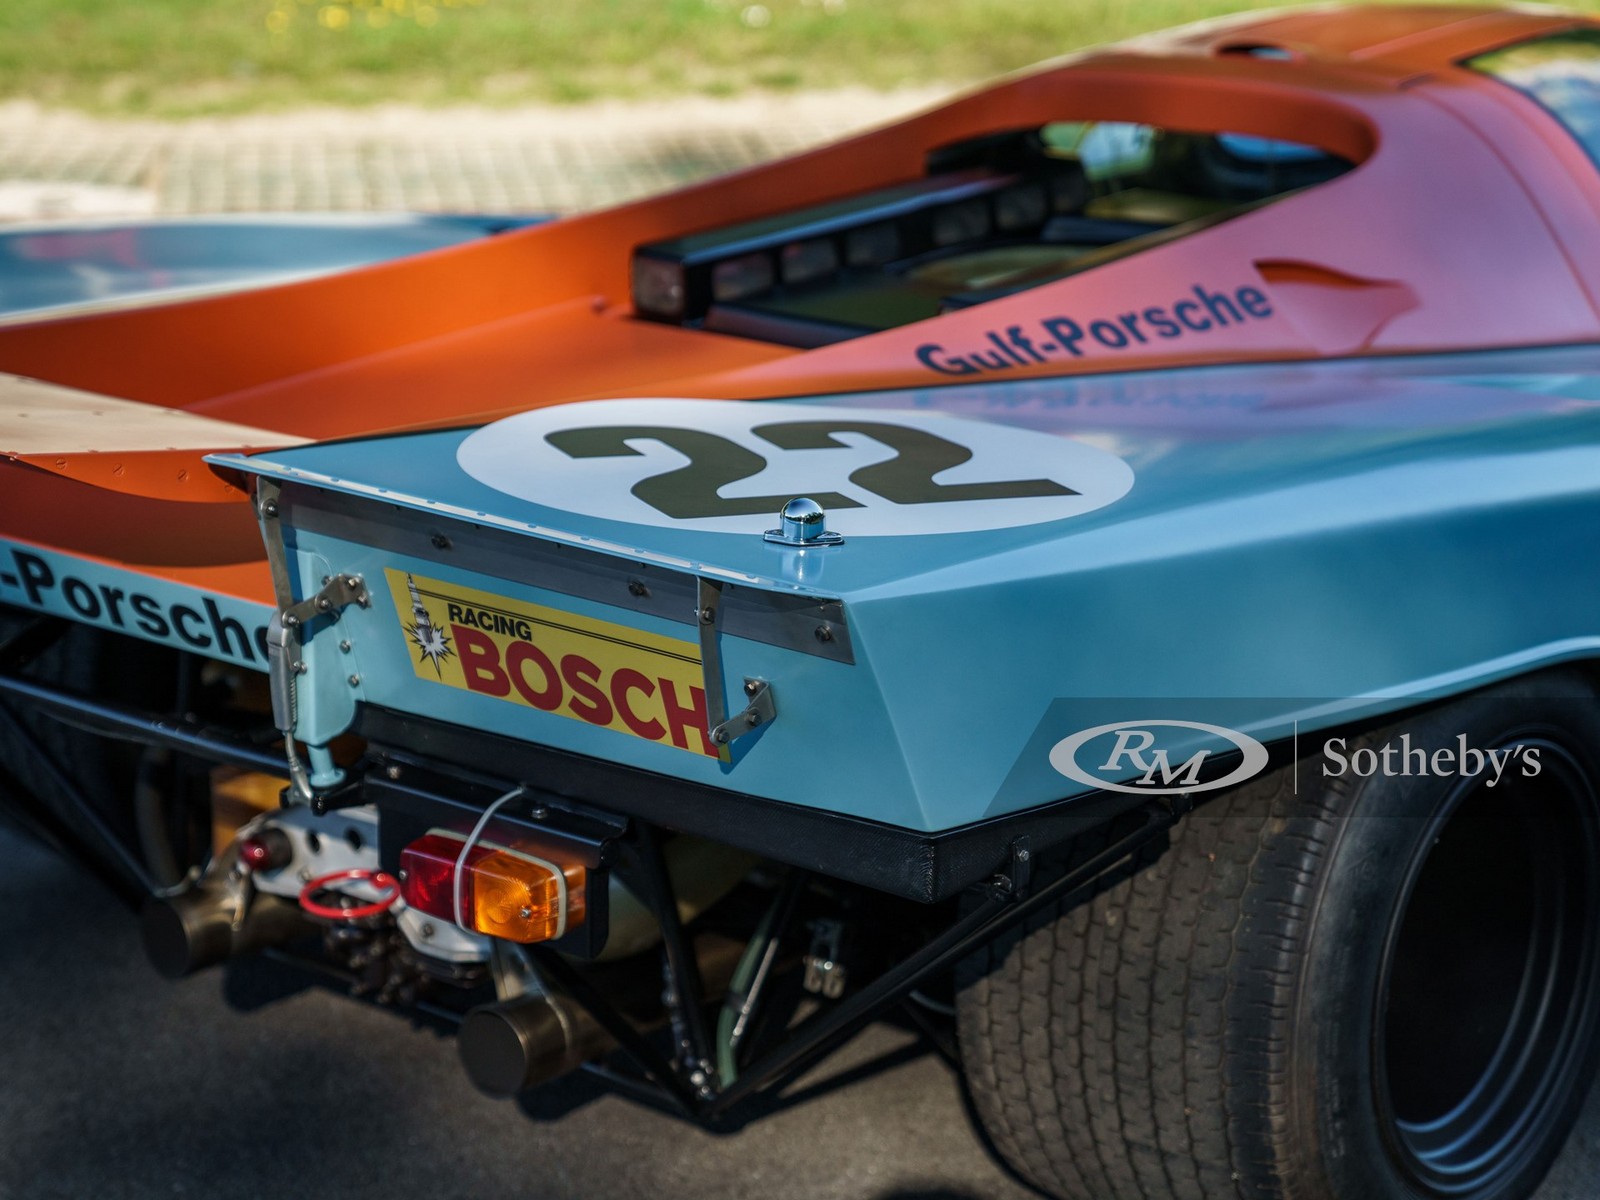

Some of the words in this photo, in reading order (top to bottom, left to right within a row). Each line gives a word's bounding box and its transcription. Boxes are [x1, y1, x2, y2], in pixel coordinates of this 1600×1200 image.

[915, 284, 1274, 375] Gulf-Porsche
[543, 420, 1083, 519] 22
[447, 602, 532, 641] RACING
[450, 623, 720, 759] BOSCH
